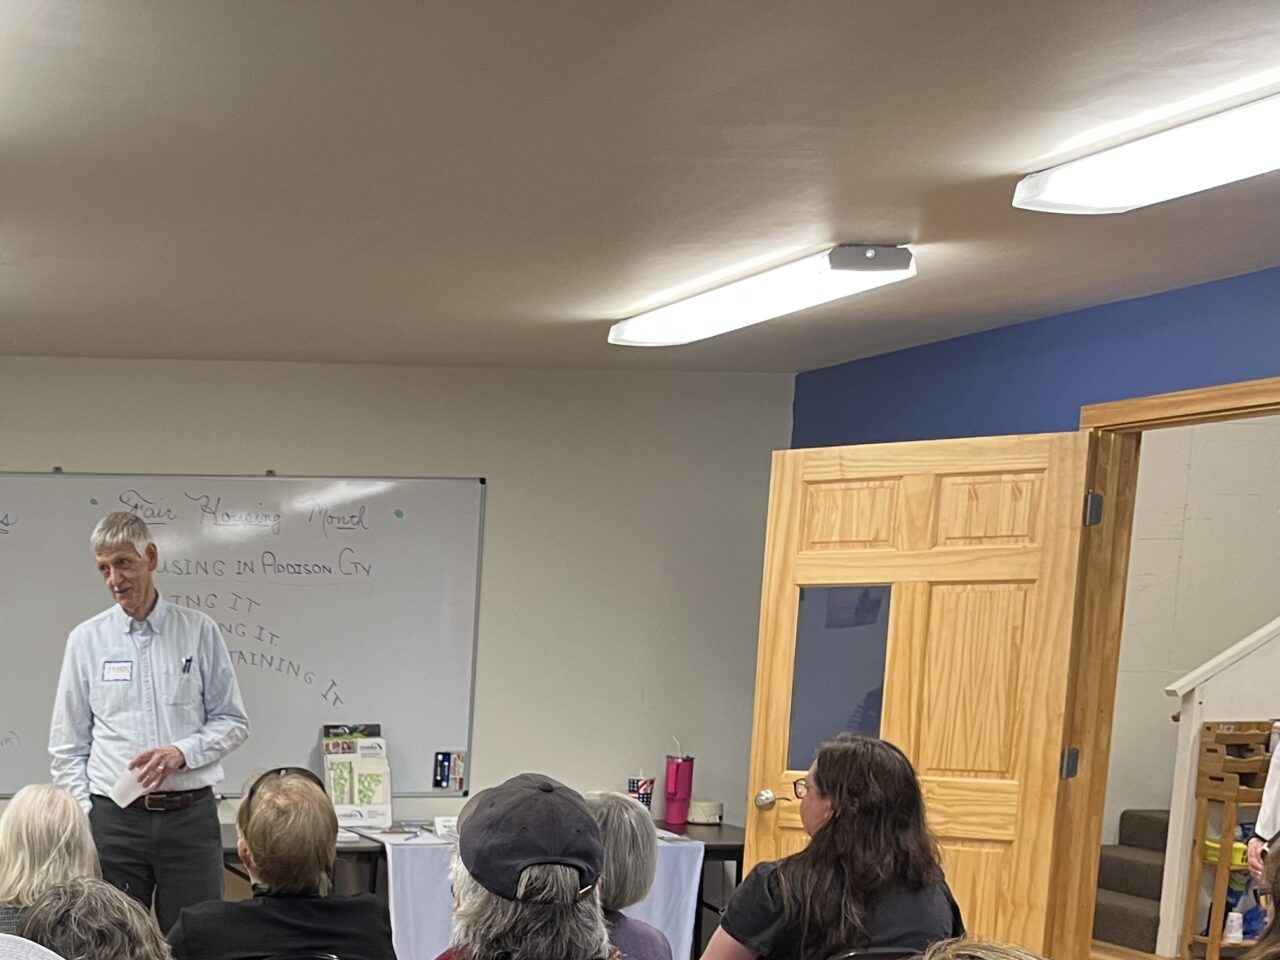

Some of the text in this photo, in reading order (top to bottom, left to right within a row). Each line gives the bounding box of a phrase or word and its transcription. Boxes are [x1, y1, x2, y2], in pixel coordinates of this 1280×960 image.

[157, 559, 226, 577] USING
[235, 559, 255, 575] IN
[228, 650, 316, 685] TAINING
